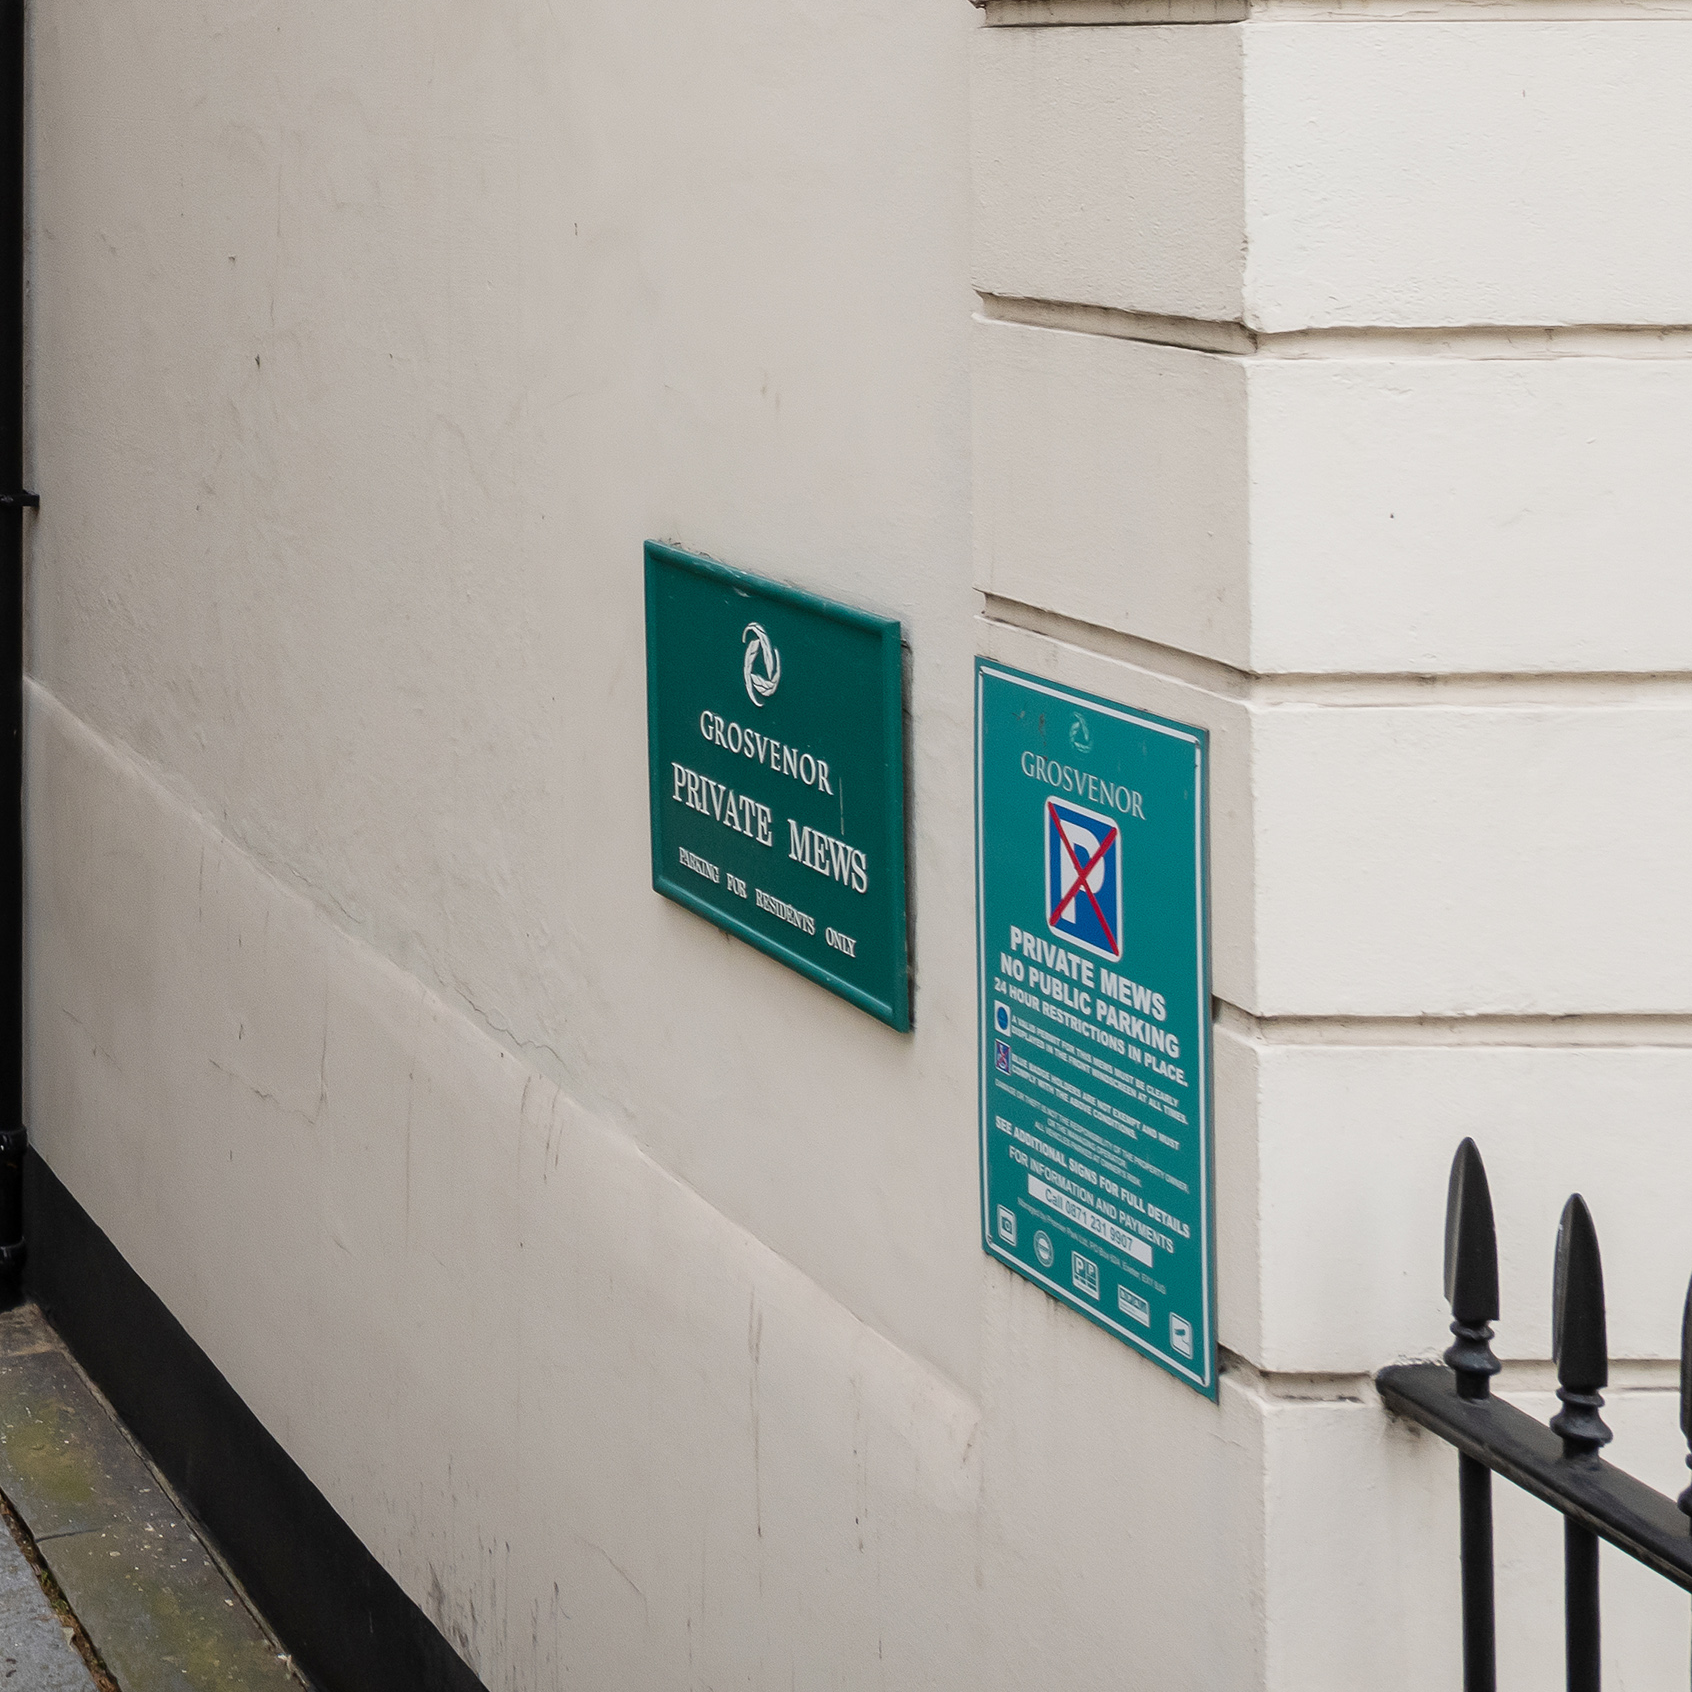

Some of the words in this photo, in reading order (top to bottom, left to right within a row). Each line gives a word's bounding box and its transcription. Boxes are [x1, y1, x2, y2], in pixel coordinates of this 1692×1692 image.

[700, 709, 833, 795] GROSVENOR
[1020, 751, 1146, 820] GROSVENOR
[671, 762, 772, 847] PRIVATE
[787, 818, 868, 896] MEWS
[678, 847, 719, 883] PARKING
[726, 873, 746, 899] FOR
[755, 888, 815, 936] RESIDENTS
[825, 927, 857, 959] ONLY
[1000, 952, 1024, 982] NO
[1028, 966, 1091, 1015] PUBLIC
[1096, 998, 1179, 1060] PARKING
[1010, 925, 1094, 988] PRIVATE
[1100, 967, 1166, 1023] MEWS
[994, 977, 1006, 994] 24
[1009, 985, 1040, 1011] HOUR
[1042, 1001, 1124, 1054] RESTRICTIONS
[1128, 1044, 1141, 1063] IN
[1144, 1052, 1188, 1086] PLACE.
[1036, 1028, 1059, 1046] PERMIT
[1061, 1041, 1074, 1053] FOR
[1076, 1048, 1091, 1062] THIS
[1114, 1068, 1134, 1084] MUST
[1135, 1078, 1145, 1090] BE
[1145, 1084, 1179, 1108] CLEARLY
[1037, 1078, 1053, 1094] WITH
[1055, 1088, 1067, 1101] THE
[1069, 1096, 1091, 1114] ABOVE
[1054, 1048, 1066, 1061] THE
[1068, 1055, 1090, 1073] FRONT
[1091, 1067, 1136, 1097] WINDSCREEN
[1137, 1091, 1147, 1103] AT
[1148, 1096, 1162, 1111] ALL
[1082, 1092, 1096, 1105] ARE
[1097, 1099, 1111, 1113] NOT
[1112, 1107, 1141, 1129] EXEMPT
[1141, 1123, 1157, 1138] AND
[1158, 1132, 1179, 1150] MUST
[996, 1116, 1011, 1135] SEE
[1013, 1126, 1067, 1167] ADDITIONAL
[1068, 1158, 1097, 1185] SIGNS
[1099, 1175, 1118, 1197] FOR
[1121, 1188, 1145, 1213] FULL
[1147, 1203, 1190, 1238] DETAILS
[1009, 1145, 1028, 1167] FOR
[1029, 1158, 1093, 1206] INFORMATION
[1095, 1196, 1116, 1219] AND
[1119, 1210, 1173, 1254] PAYMENTS
[1045, 1188, 1062, 1209] Call
[1065, 1200, 1086, 1223] 0871
[1090, 1215, 1106, 1235] 231
[1110, 1227, 1132, 1251] 9907
